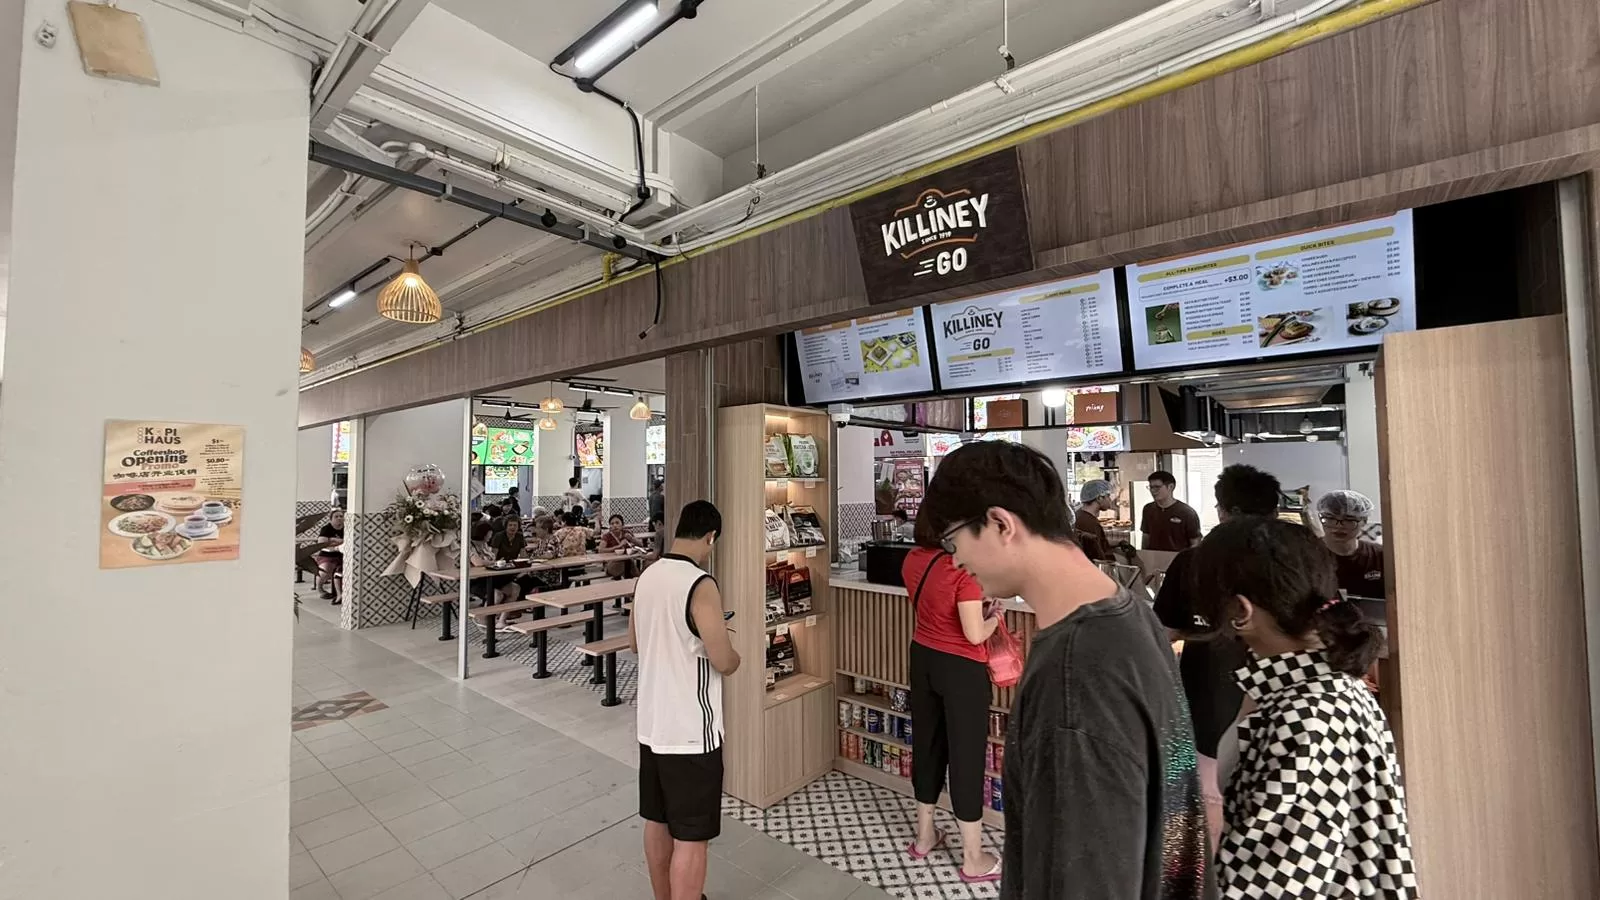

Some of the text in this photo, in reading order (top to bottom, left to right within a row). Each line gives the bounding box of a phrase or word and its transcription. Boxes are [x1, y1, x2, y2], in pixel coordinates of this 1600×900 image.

[881, 193, 989, 257] KILLINEY
[921, 236, 938, 245] SINCE
[936, 247, 967, 275] GO
[1224, 273, 1249, 283] +$3.00
[1163, 282, 1187, 291] COMPLETE
[943, 311, 1003, 339] KILLINEY
[972, 337, 990, 351] GO
[145, 436, 181, 445] HAUS
[133, 448, 185, 456] Coffeeshop
[121, 454, 188, 467] Opening
